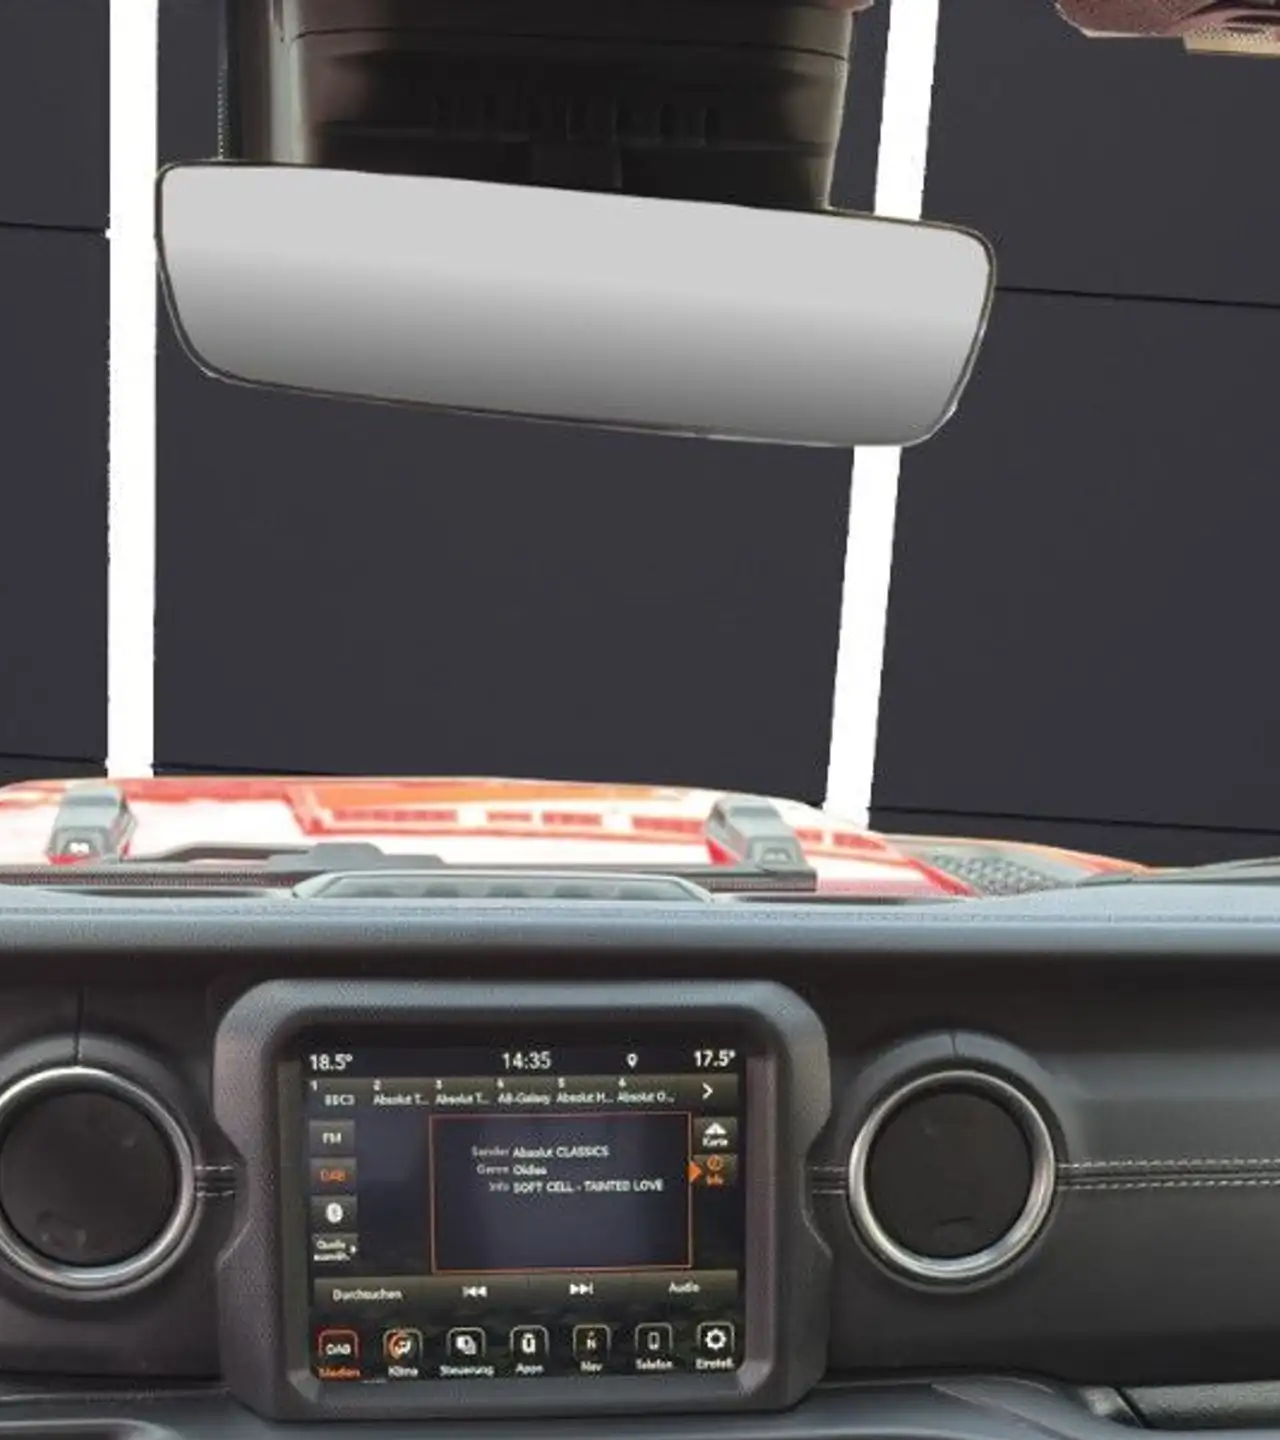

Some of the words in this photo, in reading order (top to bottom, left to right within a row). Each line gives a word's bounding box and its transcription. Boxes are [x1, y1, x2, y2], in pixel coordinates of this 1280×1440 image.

[309, 1053, 354, 1071] 18.5°
[502, 1051, 552, 1070] 14:35
[693, 1050, 737, 1068] 17.5°
[309, 1079, 318, 1091] 1
[322, 1131, 342, 1145] FM
[556, 1145, 610, 1158] CLASSICS
[546, 1180, 575, 1193] CELL
[583, 1179, 631, 1193] TAINTED
[633, 1178, 664, 1192] LOVE
[332, 1287, 404, 1302] Durchsuchen
[668, 1281, 701, 1294] Audio
[387, 1365, 420, 1378] Klima
[515, 1362, 544, 1376] Apps
[580, 1360, 604, 1373] Nav
